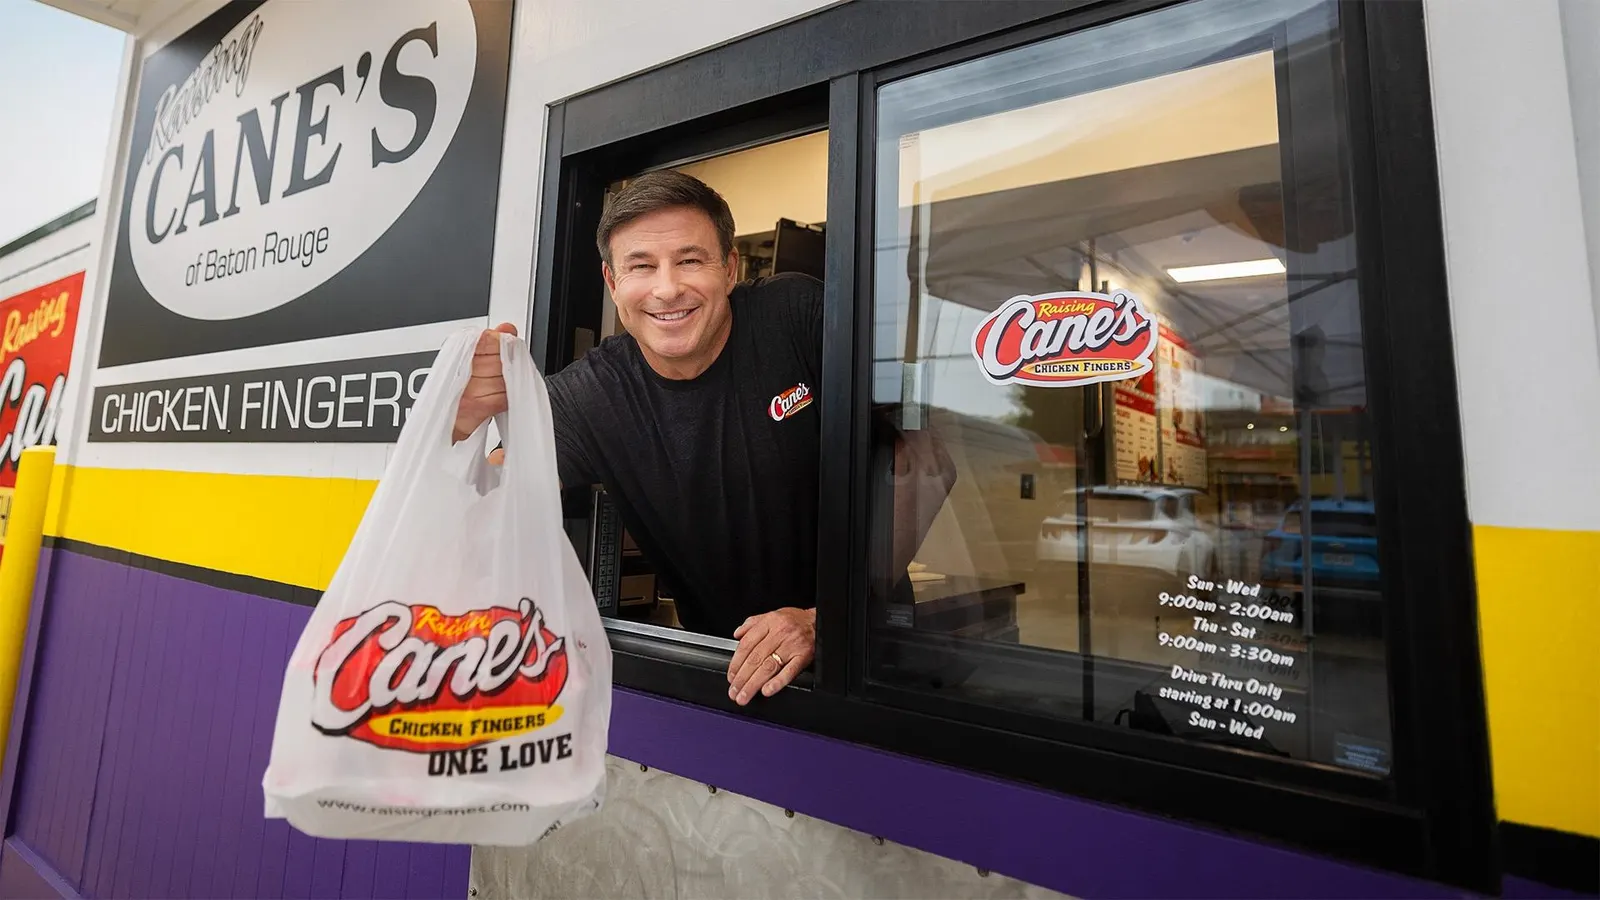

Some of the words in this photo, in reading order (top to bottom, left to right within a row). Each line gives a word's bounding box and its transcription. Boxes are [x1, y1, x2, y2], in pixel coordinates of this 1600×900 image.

[146, 13, 264, 165] Raising
[144, 20, 440, 246] CANE'S
[184, 252, 203, 287] of
[204, 246, 257, 282] Baton
[261, 226, 330, 268] Rouge
[1037, 300, 1096, 318] Raising
[982, 293, 1150, 379] Cane's
[1034, 361, 1080, 374] CHICKEN
[1083, 360, 1132, 373] FINGERS
[101, 384, 231, 434] CHICKEN
[770, 382, 811, 422] Cane's
[1186, 574, 1215, 592] Sun
[1226, 579, 1261, 598] Wed
[1158, 592, 1217, 614] 9:00am
[1229, 601, 1294, 624] 2:00am
[1193, 616, 1219, 634] Thu
[1229, 621, 1257, 640] Sat
[310, 597, 565, 736] Cane's
[1158, 632, 1217, 654] 9:00am
[1229, 643, 1295, 667] 3:30am
[1159, 687, 1212, 709] starting
[1213, 697, 1230, 710] at
[1170, 664, 1208, 685] Drive
[1210, 671, 1244, 692] Thru
[1245, 678, 1283, 701] Only
[388, 718, 463, 737] CHICKEN
[470, 713, 546, 736] FINGERS
[1188, 711, 1217, 730] Sun
[1228, 718, 1265, 740] Wed
[427, 748, 489, 777] ONE
[499, 733, 573, 773] LOVE
[316, 799, 531, 818] www.raisingcanes.com
